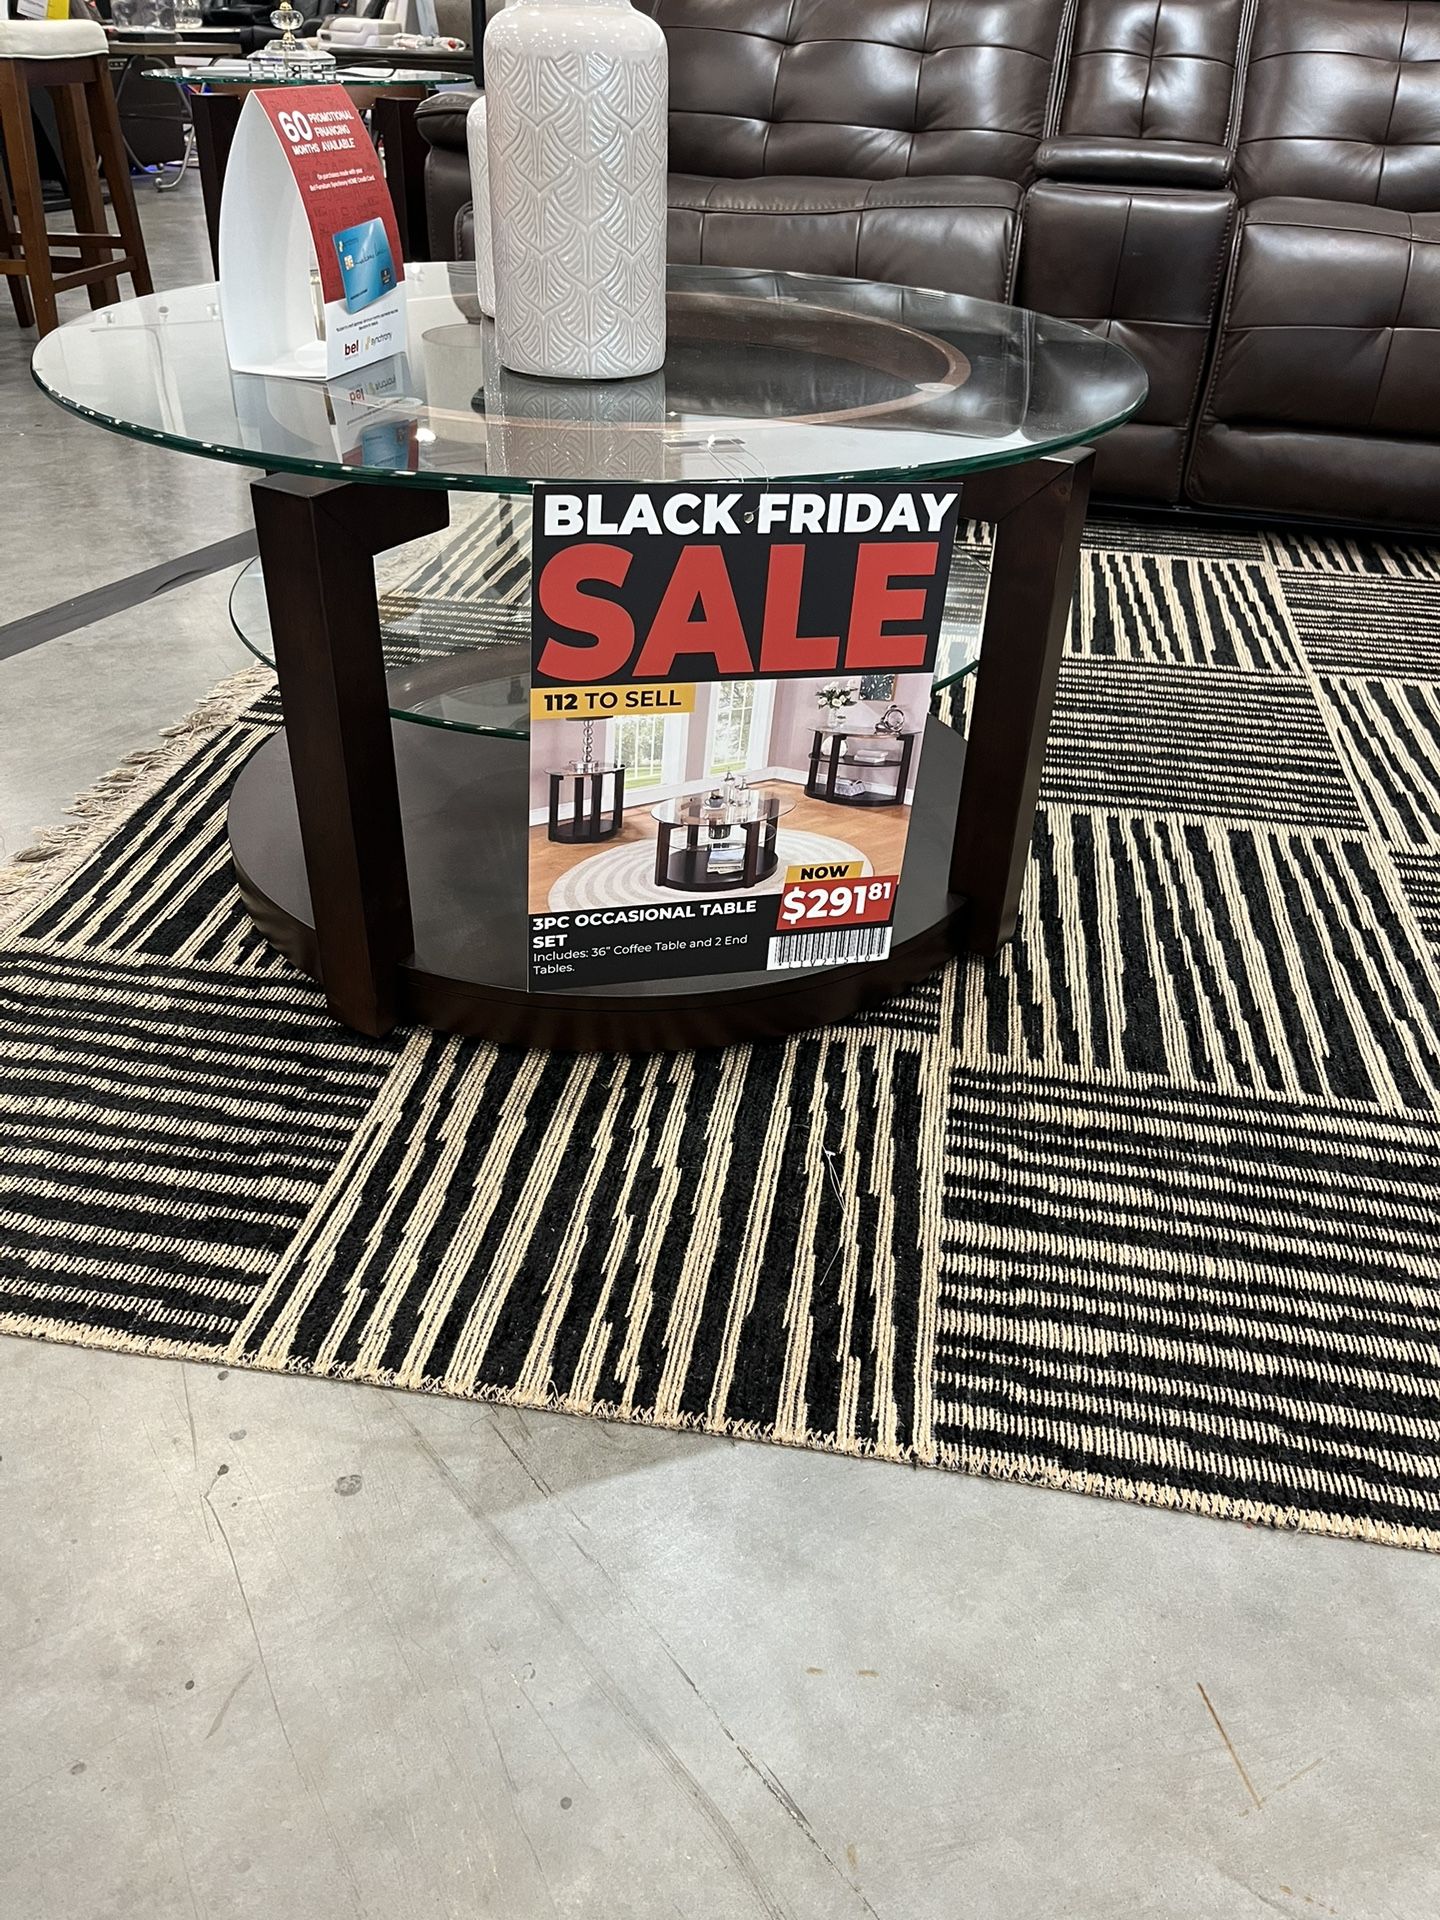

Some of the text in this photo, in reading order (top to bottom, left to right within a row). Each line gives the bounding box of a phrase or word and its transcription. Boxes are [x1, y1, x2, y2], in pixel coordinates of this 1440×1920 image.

[278, 110, 354, 142] 60 PROMOTIONAL
[314, 124, 351, 137] FINANCING
[291, 138, 356, 156] MONTHS AVAILABLE
[345, 339, 359, 356] bel
[543, 492, 959, 536] BLACK FRIDAY
[536, 541, 940, 682] SALE
[544, 689, 682, 711] 112 TO SELL
[801, 865, 849, 880] NOW
[532, 900, 757, 931] 3PC OCCASIONAL TABLE
[532, 933, 568, 949] SET
[533, 934, 748, 962] Includes: 36" Coffee Table and 2 End
[533, 963, 575, 975] Tables.
